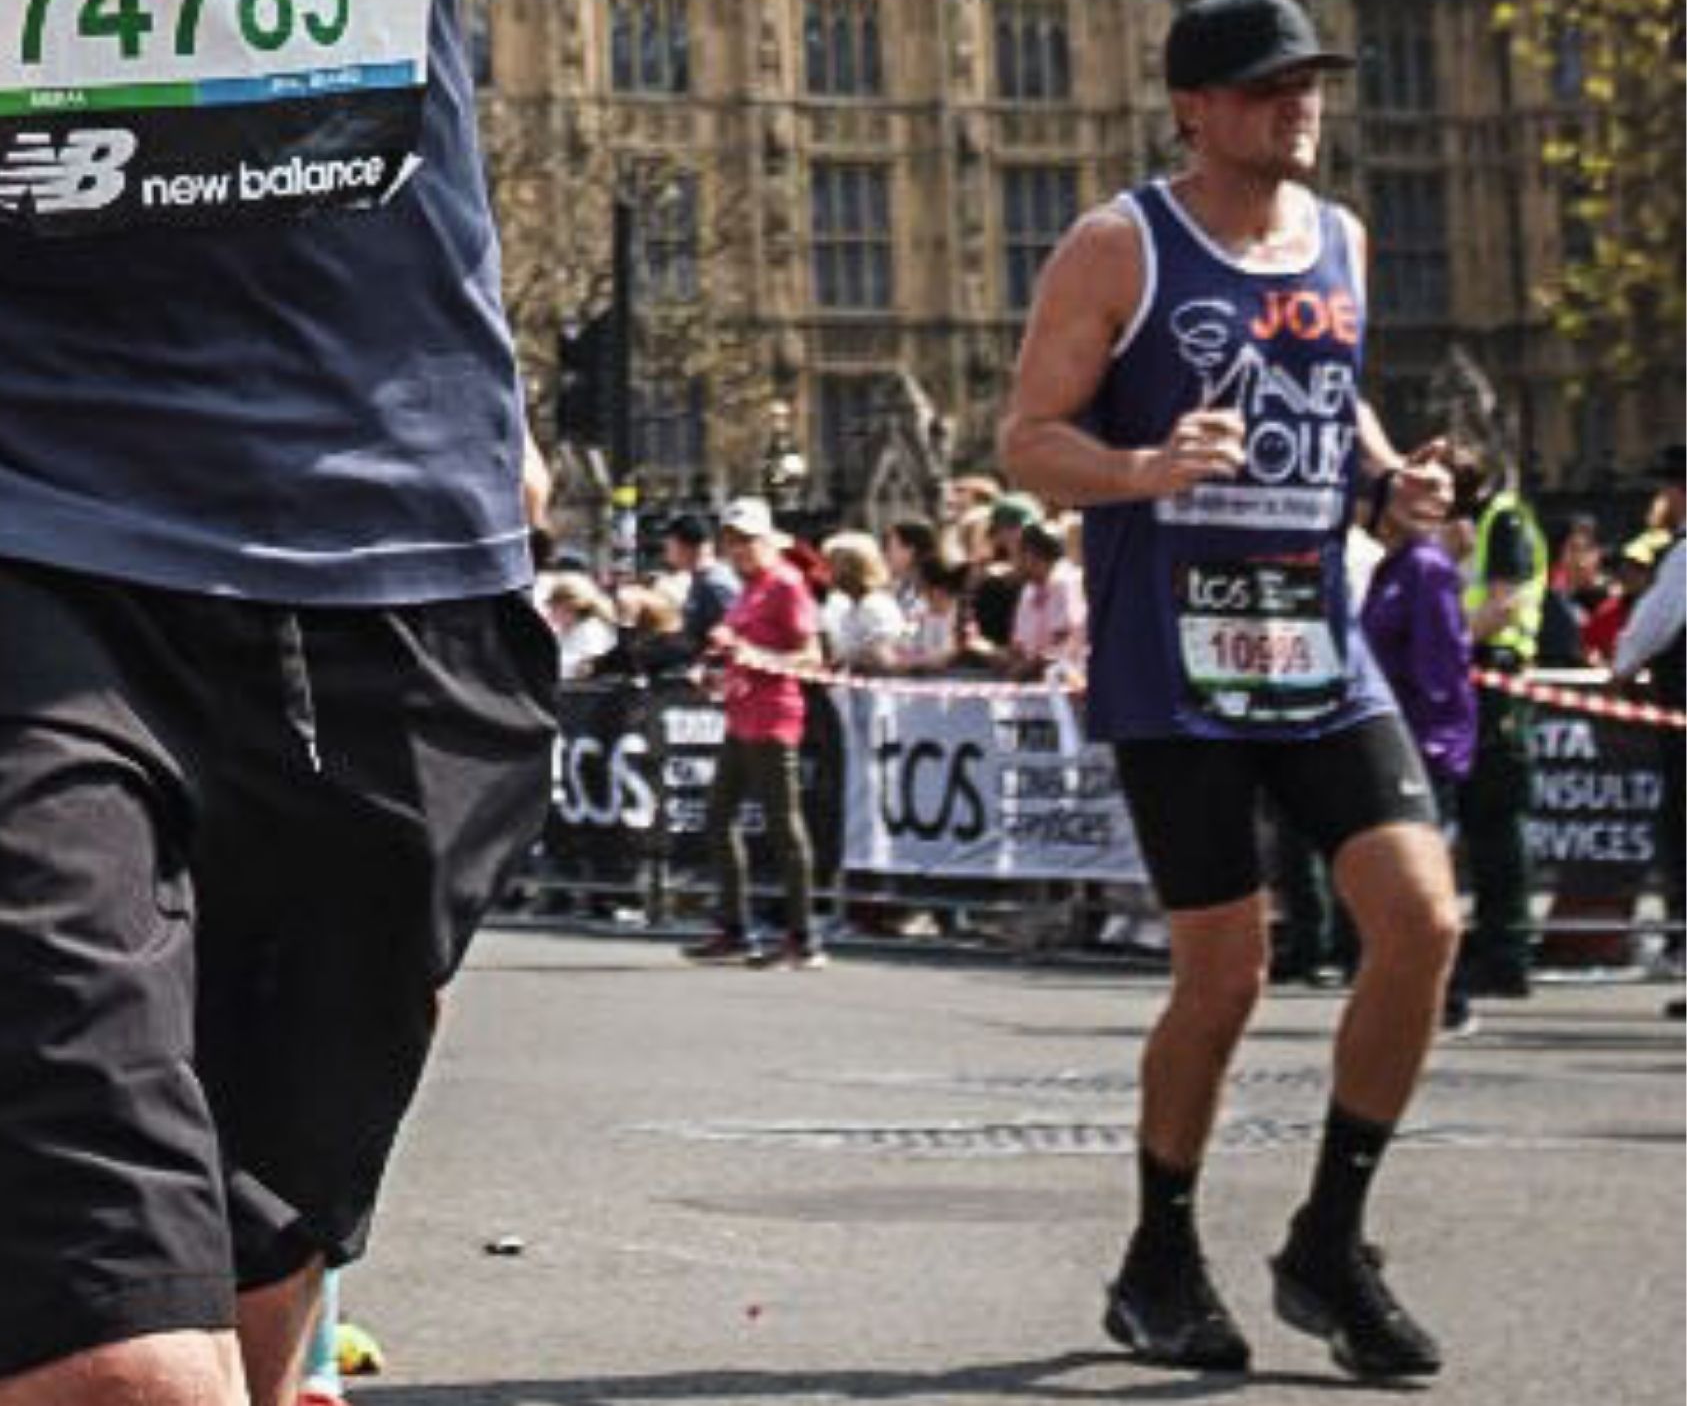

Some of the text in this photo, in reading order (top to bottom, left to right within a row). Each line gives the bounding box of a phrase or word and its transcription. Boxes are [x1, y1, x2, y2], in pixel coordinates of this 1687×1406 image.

[141, 155, 386, 206] new balance
[1249, 291, 1359, 347] JOE
[875, 715, 986, 843] tcs
